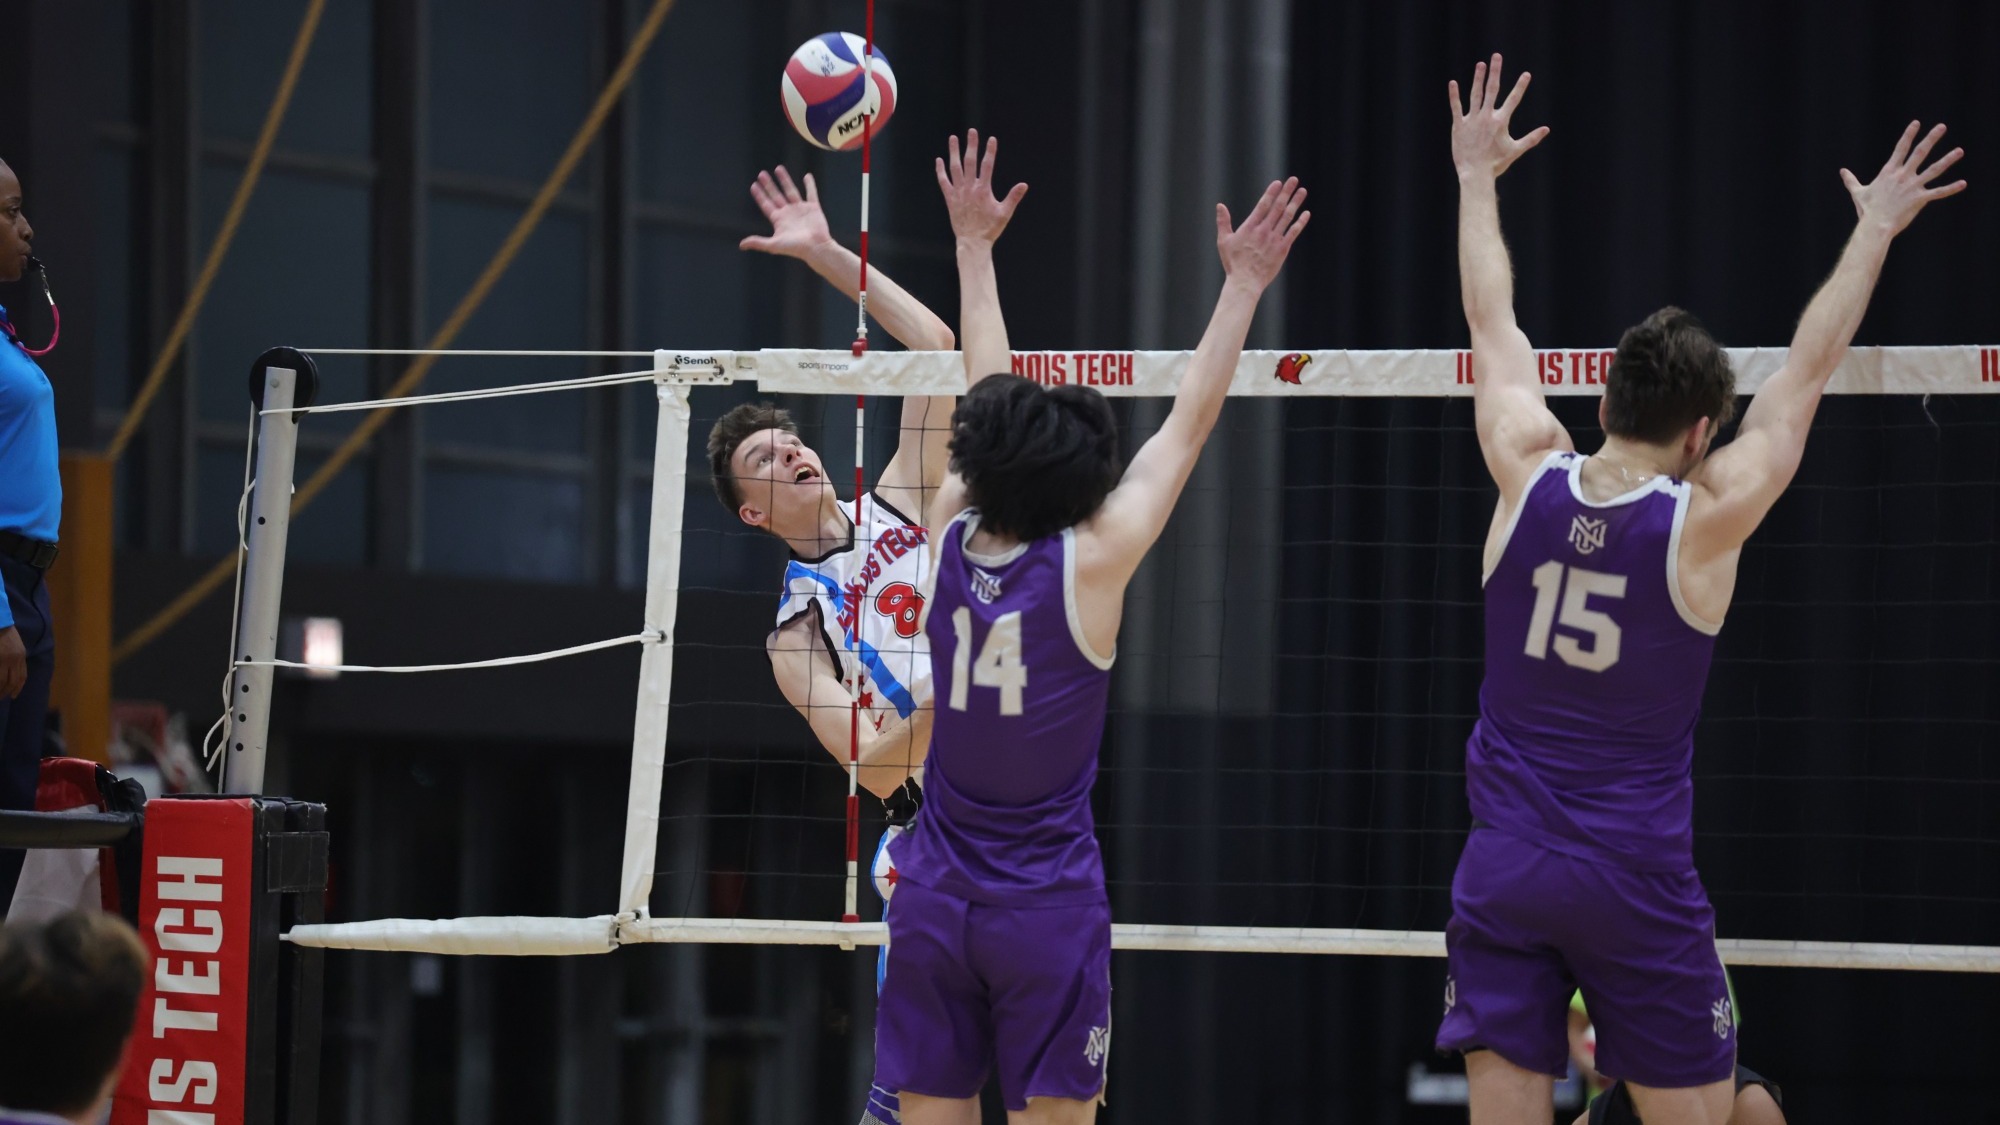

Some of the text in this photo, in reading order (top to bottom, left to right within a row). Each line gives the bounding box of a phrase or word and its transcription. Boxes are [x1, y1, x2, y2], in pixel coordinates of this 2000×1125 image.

[683, 357, 717, 365] Senoh
[1011, 353, 1133, 386] NOIS TECH
[1569, 352, 1616, 385] TEC
[874, 581, 926, 638] 8
[1524, 560, 1628, 673] 15
[949, 606, 1027, 715] 14
[153, 856, 223, 1039] TECH
